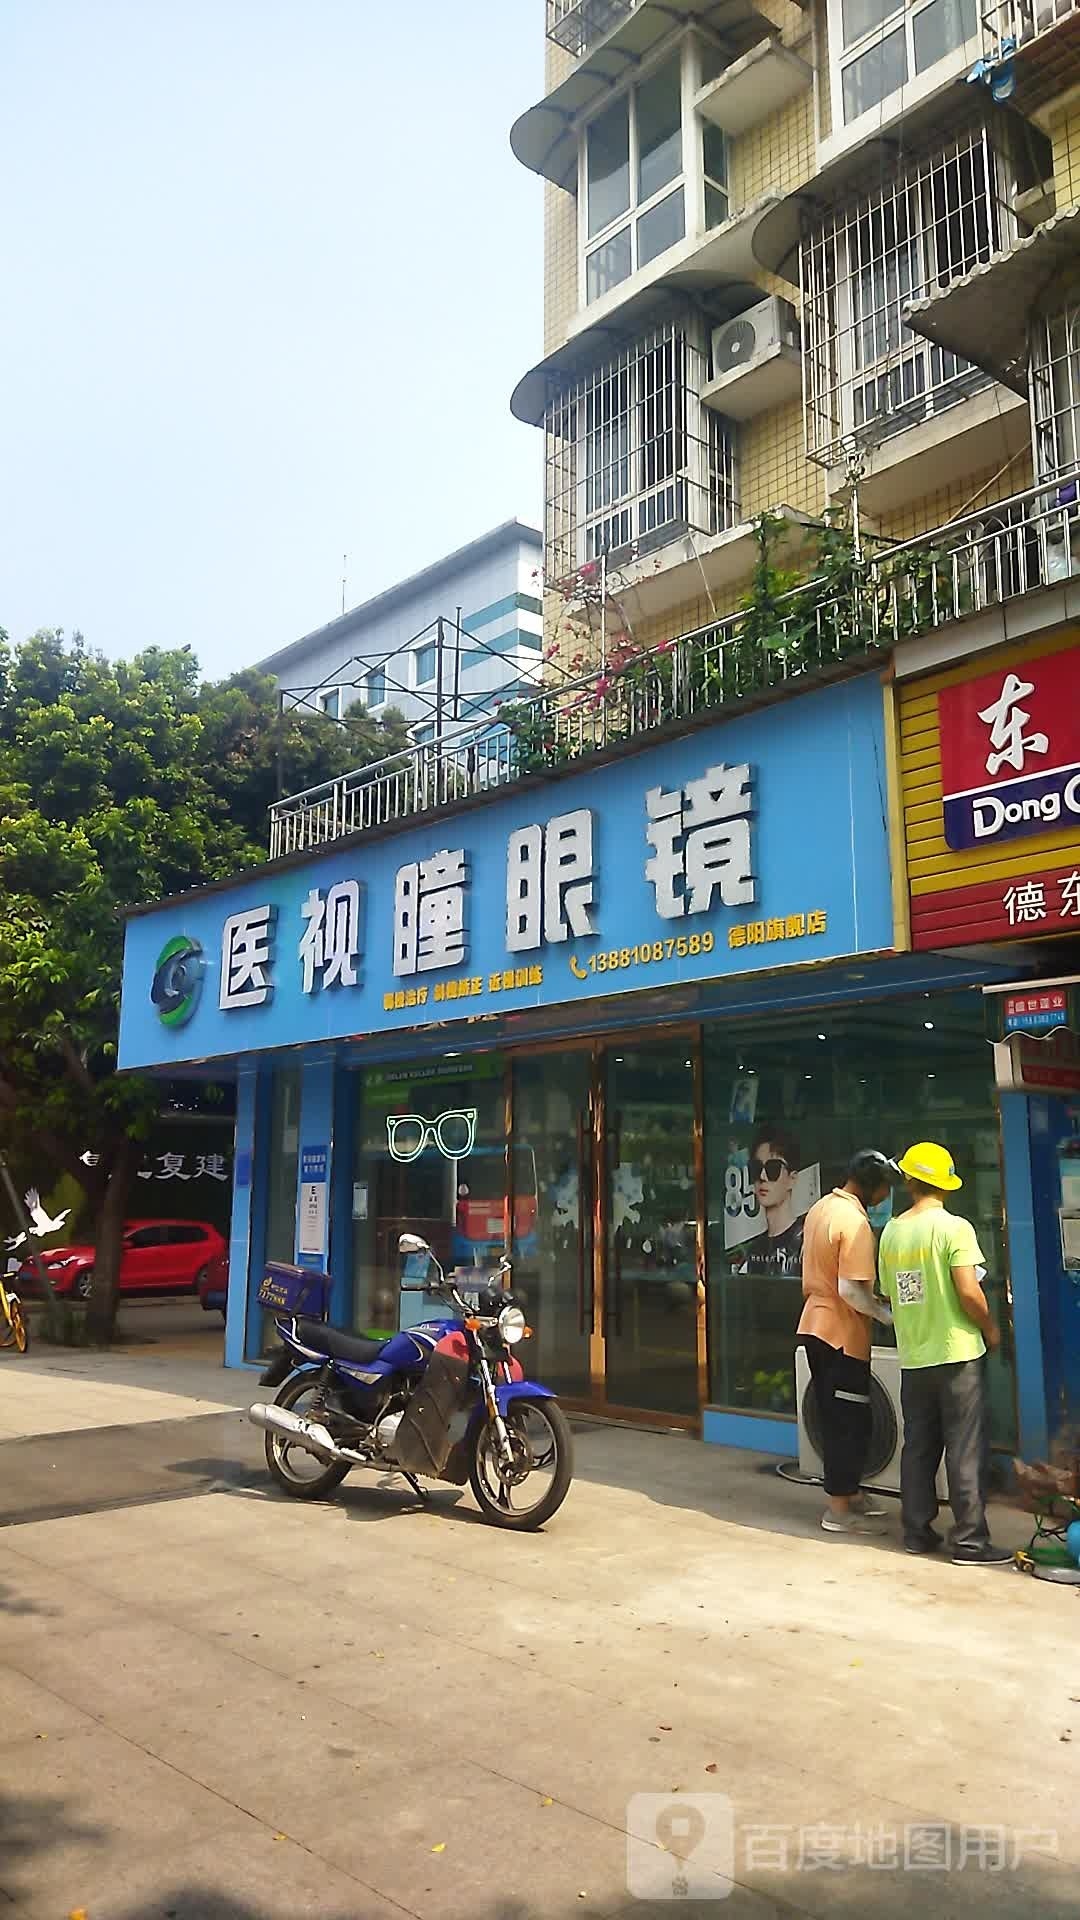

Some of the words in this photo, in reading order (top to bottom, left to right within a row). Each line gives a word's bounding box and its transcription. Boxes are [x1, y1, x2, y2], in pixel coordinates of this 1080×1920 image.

[977, 673, 1049, 776] 东
[219, 763, 757, 1010] 医视瞳眼镜
[728, 908, 828, 948] 德阳旗舰店
[588, 931, 714, 972] 13881087589
[138, 1152, 228, 1181] 复建
